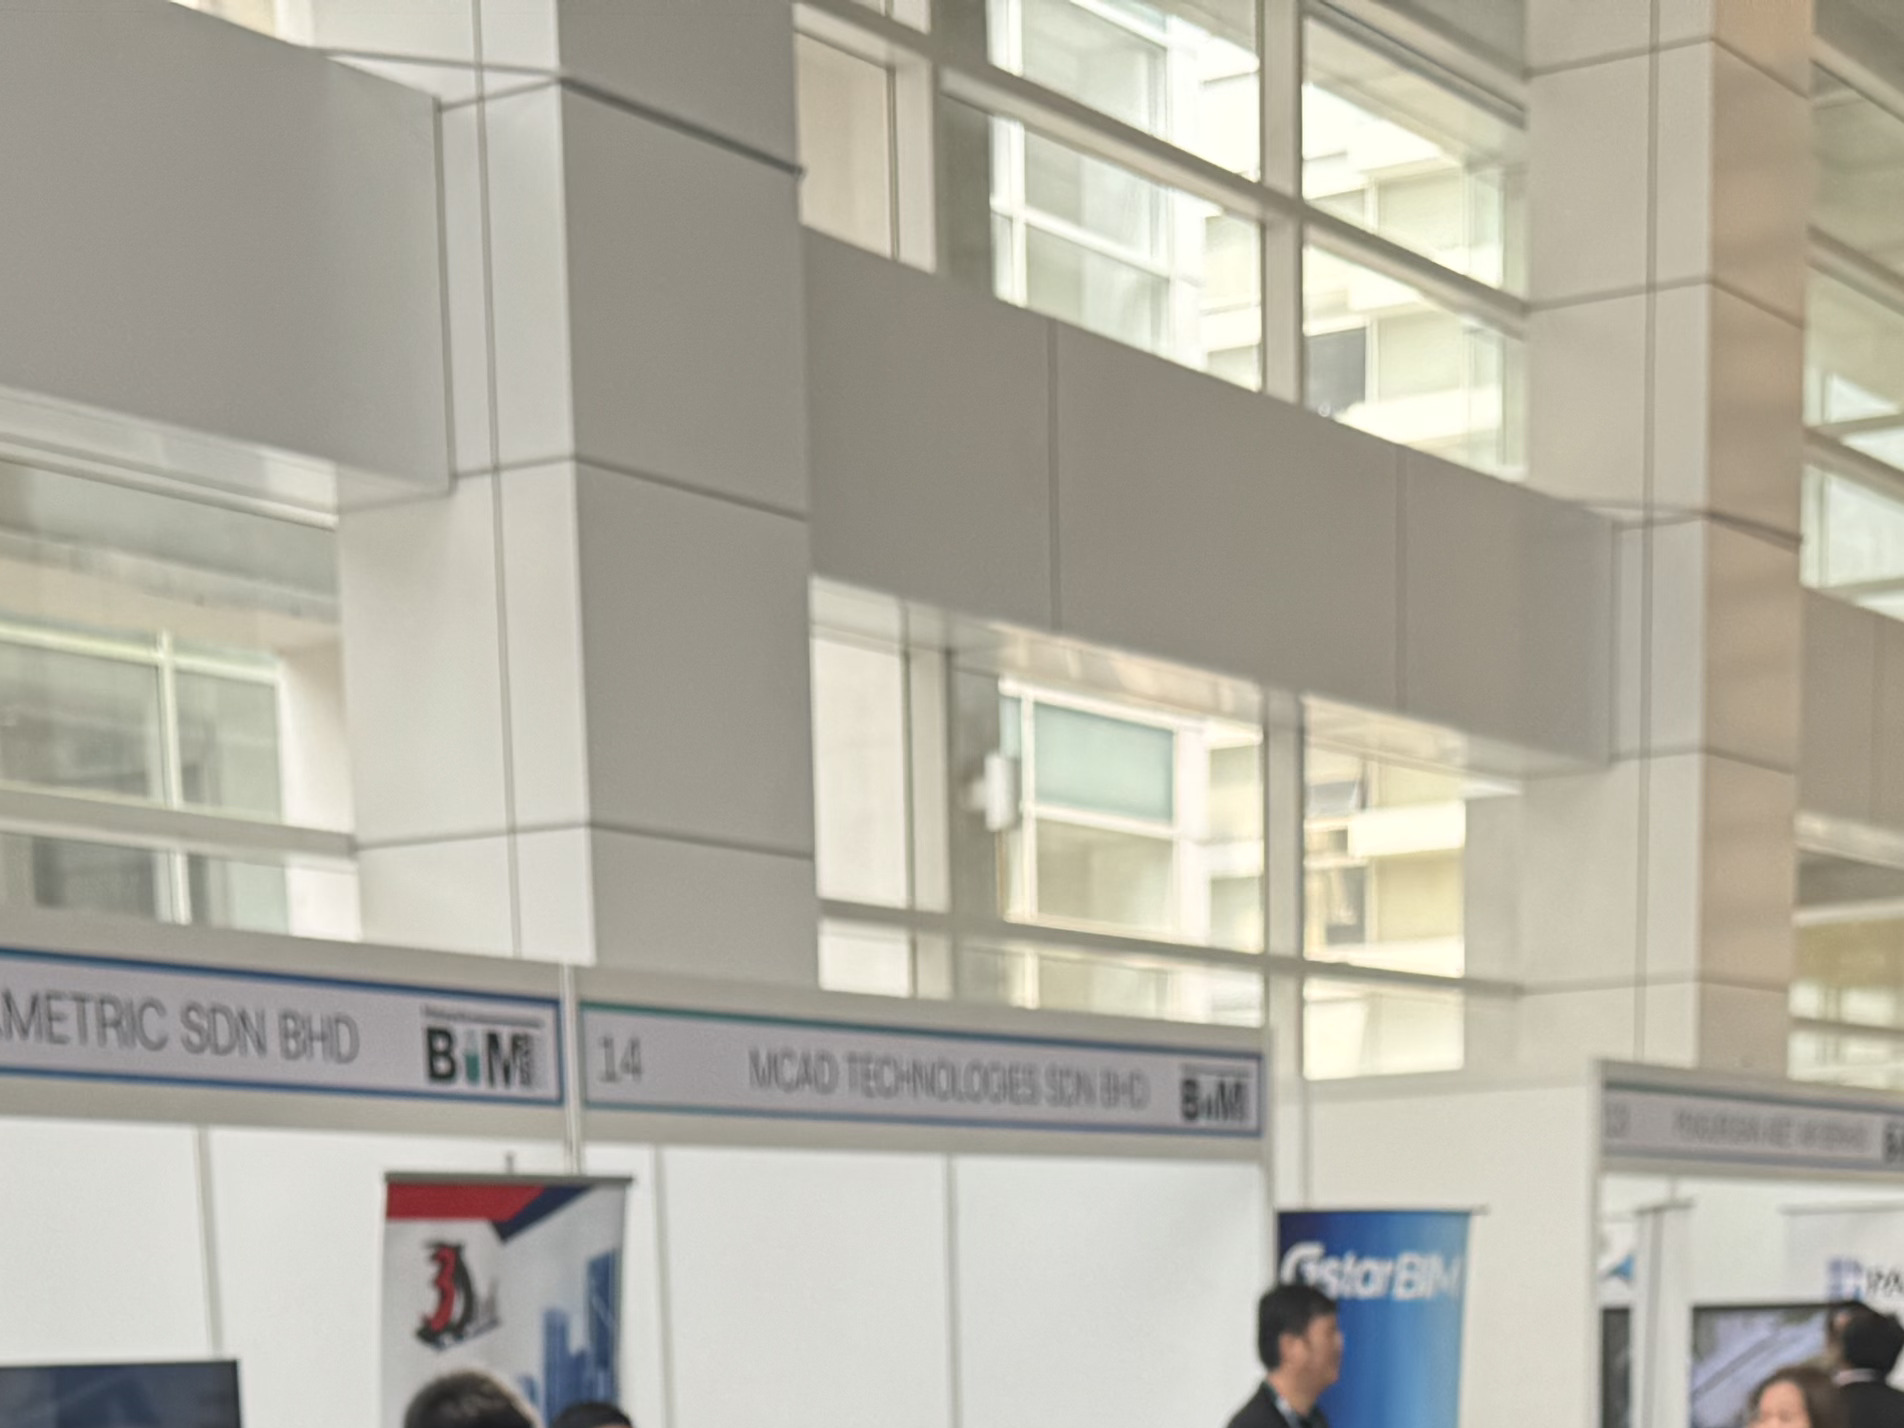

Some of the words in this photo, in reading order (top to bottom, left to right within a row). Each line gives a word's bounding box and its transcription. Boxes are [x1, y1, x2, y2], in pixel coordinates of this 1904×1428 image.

[179, 1002, 267, 1060] SDN
[278, 1010, 361, 1064] BHD
[598, 1036, 642, 1084] 14
[748, 1046, 839, 1095] MCAD
[846, 1050, 1037, 1108] TECHNOLOGIES
[1042, 1065, 1094, 1110] SDN
[1099, 1068, 1150, 1110] BHD
